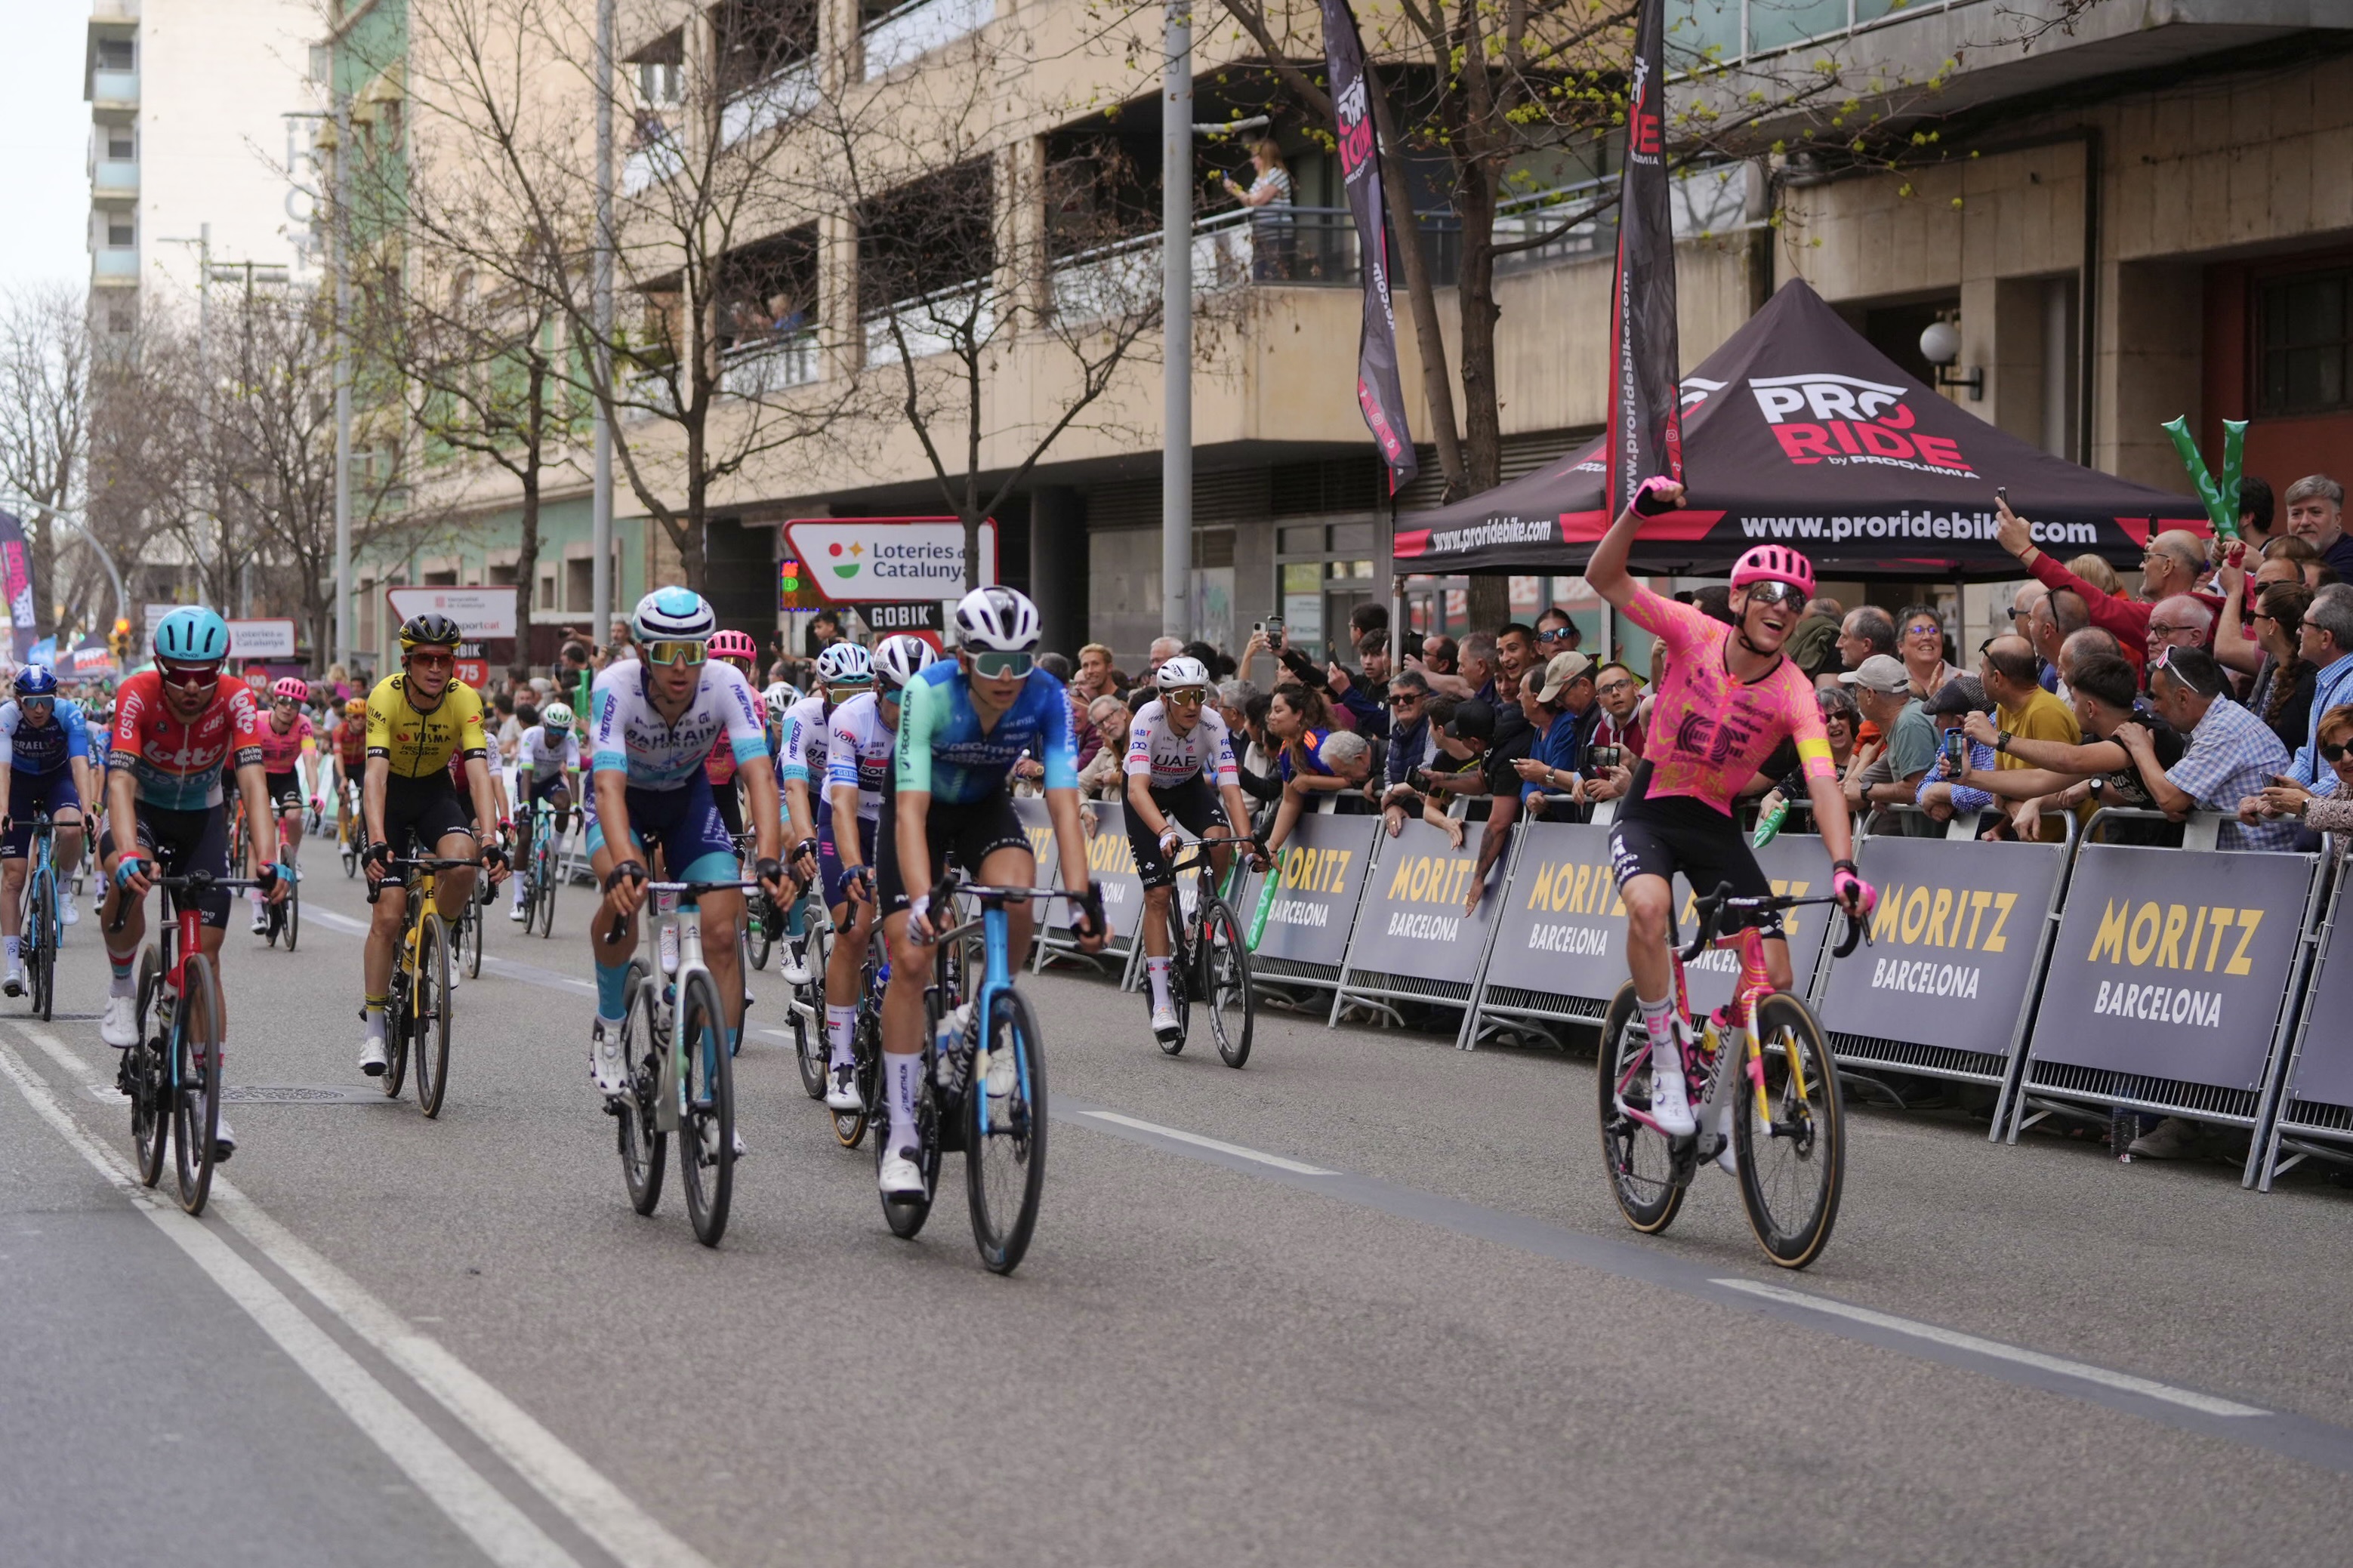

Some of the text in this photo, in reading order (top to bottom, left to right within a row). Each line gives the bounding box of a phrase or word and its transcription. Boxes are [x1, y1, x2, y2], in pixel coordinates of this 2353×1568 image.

[1751, 383, 1916, 430] PRO
[1771, 420, 1973, 471] RIDE
[1828, 455, 1981, 479] by PROQUIMIA
[1433, 516, 1551, 553] www.proridebike.com
[1741, 510, 2097, 544] www.proridebikcom
[874, 541, 954, 559] Loteries
[458, 621, 499, 630] sportcat
[871, 605, 931, 627] GOBIK
[454, 644, 481, 658] BIK
[245, 675, 267, 685] 100
[458, 664, 480, 679] 75
[599, 693, 618, 744] MERIDA
[625, 724, 717, 745] BAHRAIN
[900, 690, 913, 755] DECATHLON
[14, 740, 45, 750] SRAEL
[789, 719, 803, 761] MERIDA
[1154, 754, 1197, 767] UAE
[1024, 827, 1053, 864] ITZ
[1387, 854, 1477, 905] MORIT
[1267, 898, 1329, 928] BARCELONA
[1387, 912, 1460, 943] BARCELONA
[1870, 882, 2018, 953] MORITZ
[1528, 923, 1608, 957] BARCELONA
[2087, 896, 2265, 975] MORITZ
[1683, 941, 1742, 975] ARCEL
[1871, 957, 1980, 1000] BARCELONA
[2093, 980, 2222, 1028] BARCELONA
